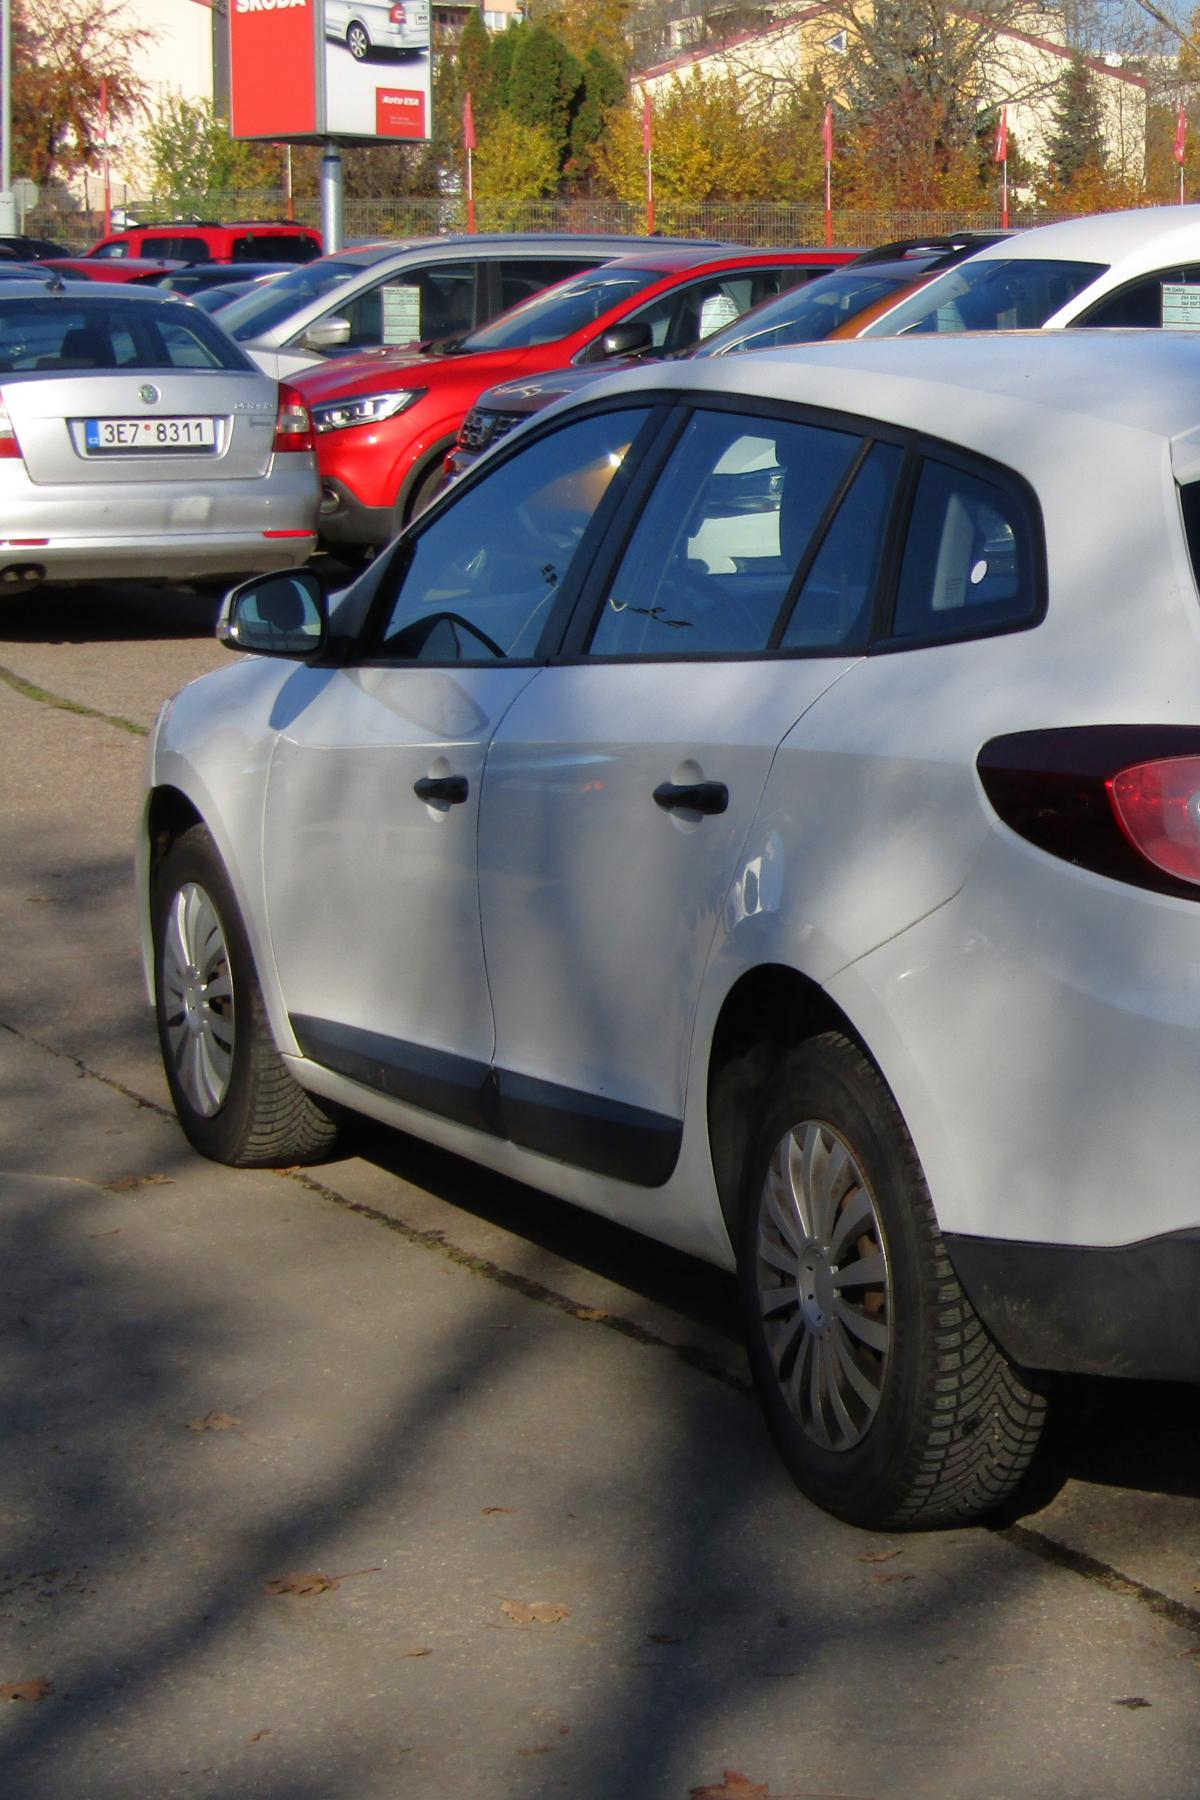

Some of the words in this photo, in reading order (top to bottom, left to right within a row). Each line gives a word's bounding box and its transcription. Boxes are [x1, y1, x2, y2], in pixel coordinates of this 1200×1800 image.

[382, 96, 403, 105] Auto
[404, 97, 419, 106] ESA
[104, 423, 140, 444] 3E7
[156, 422, 204, 443] 8311
